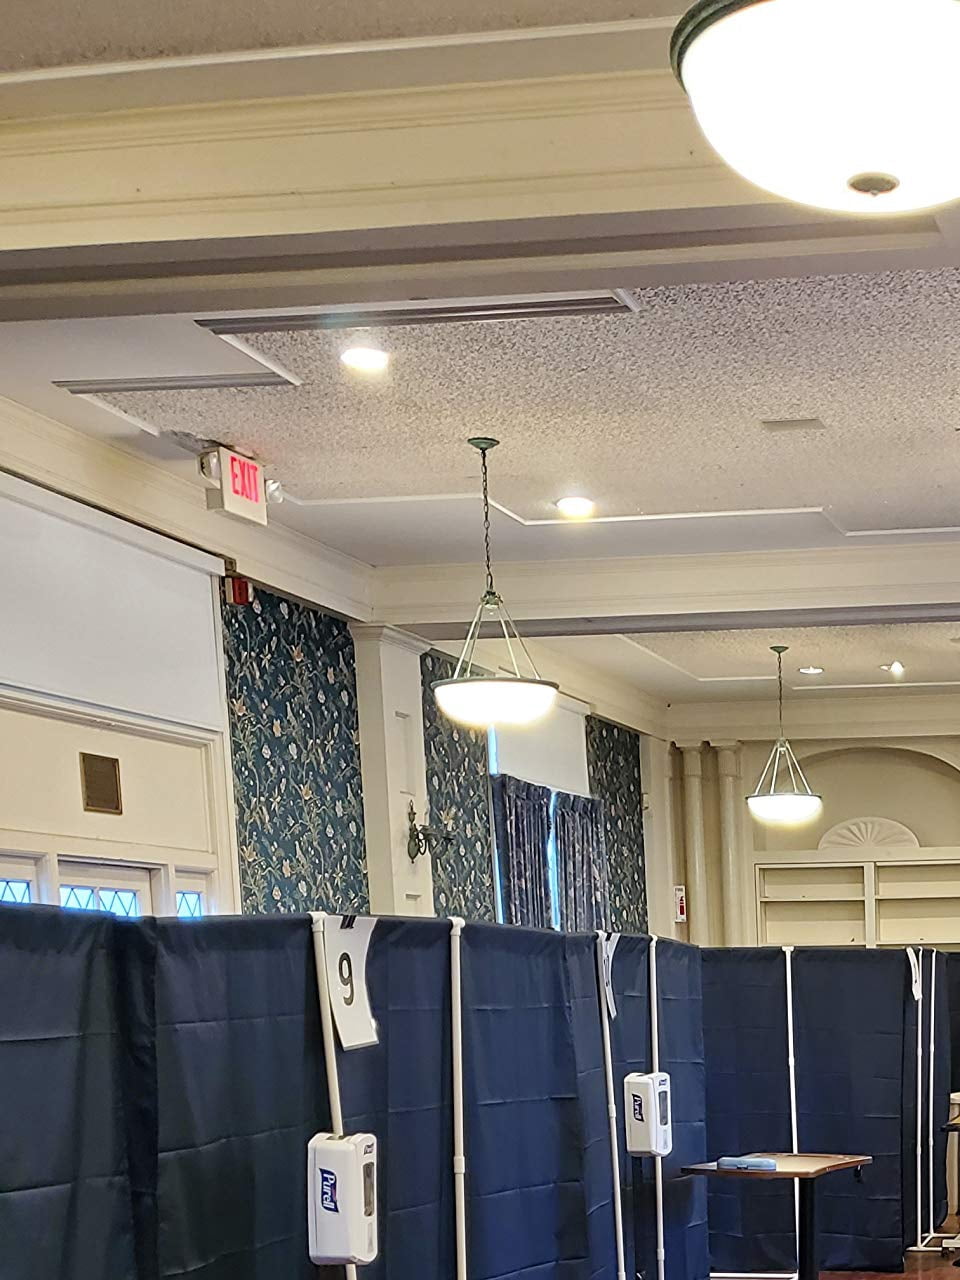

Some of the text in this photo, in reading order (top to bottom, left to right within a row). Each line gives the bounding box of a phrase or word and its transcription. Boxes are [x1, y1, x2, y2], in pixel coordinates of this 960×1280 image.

[230, 455, 259, 504] EXIT
[338, 952, 355, 1007] 9
[322, 1172, 336, 1209] Purell
